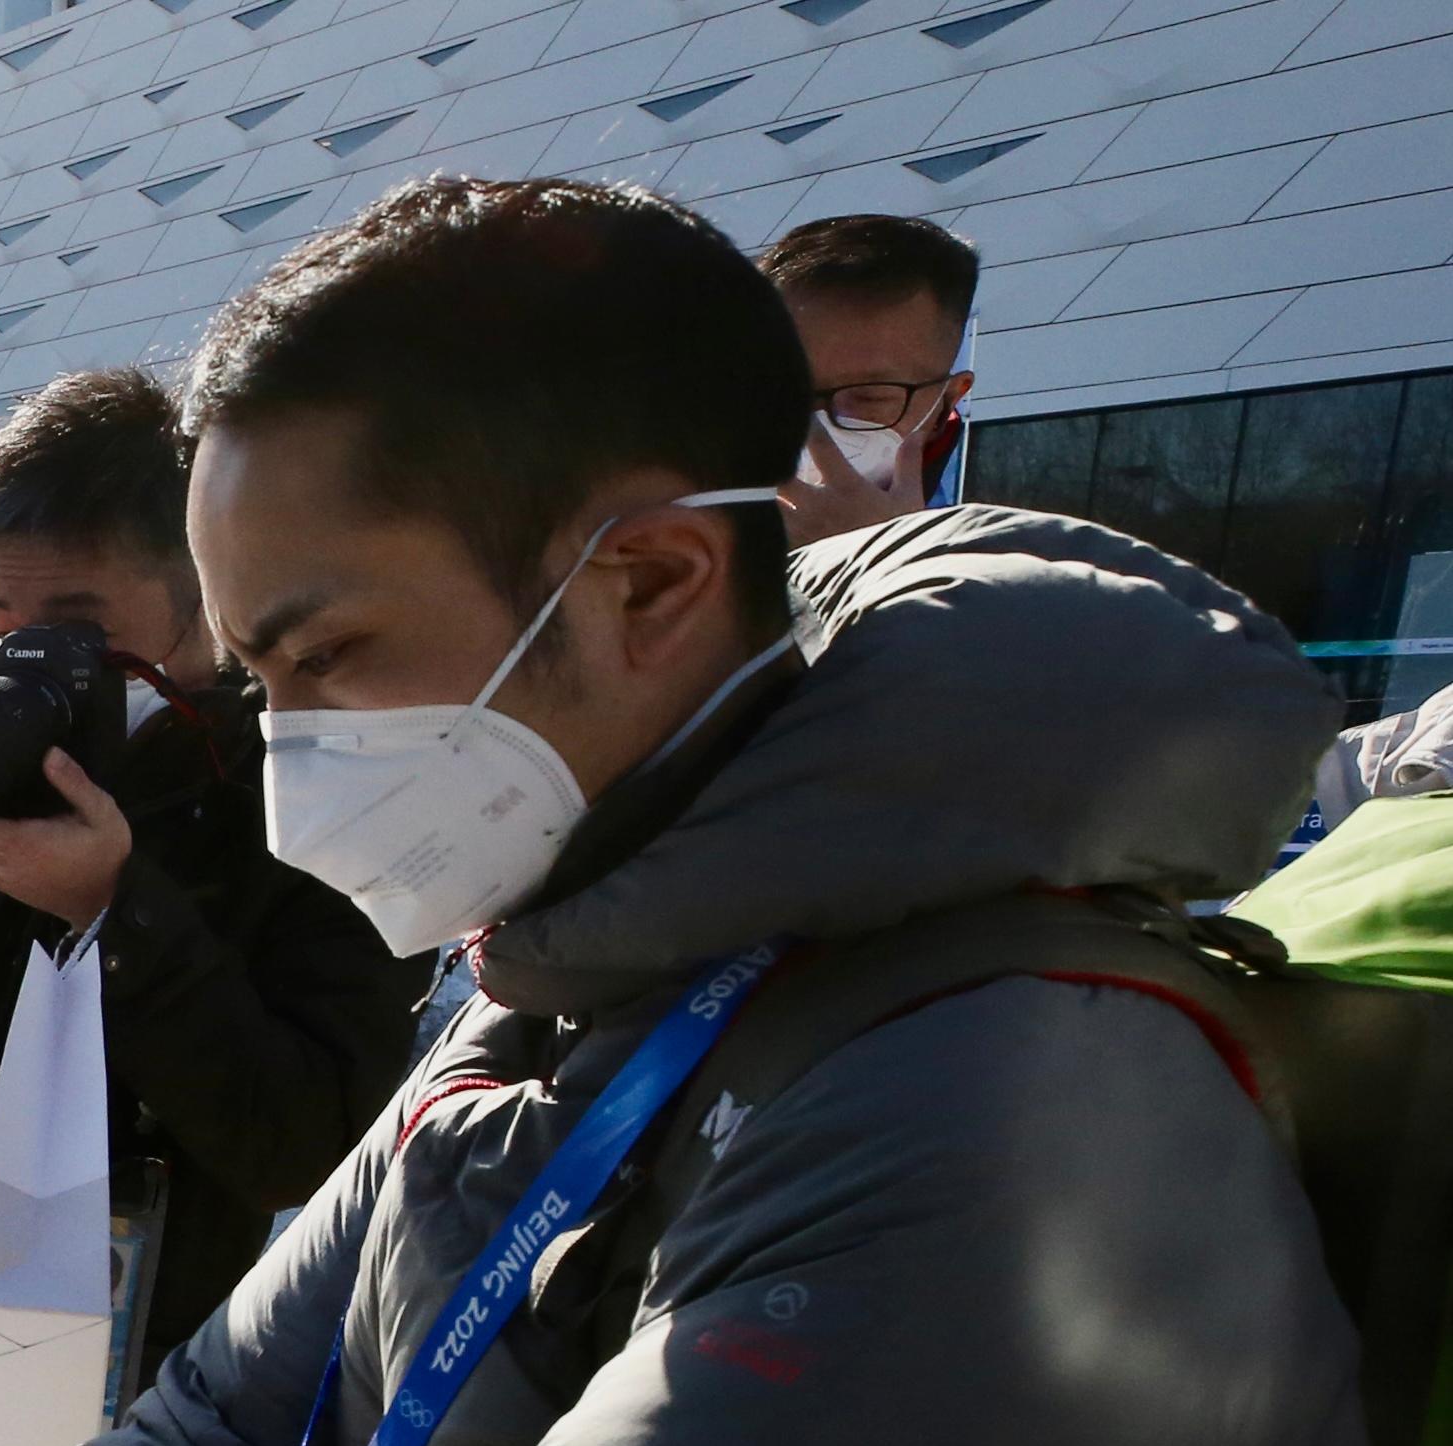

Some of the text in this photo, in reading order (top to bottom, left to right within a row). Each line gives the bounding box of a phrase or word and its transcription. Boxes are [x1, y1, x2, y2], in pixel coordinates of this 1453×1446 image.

[6, 648, 45, 659] Canon
[1300, 813, 1323, 829] ra
[429, 1190, 571, 1374] BEIJING 2022
